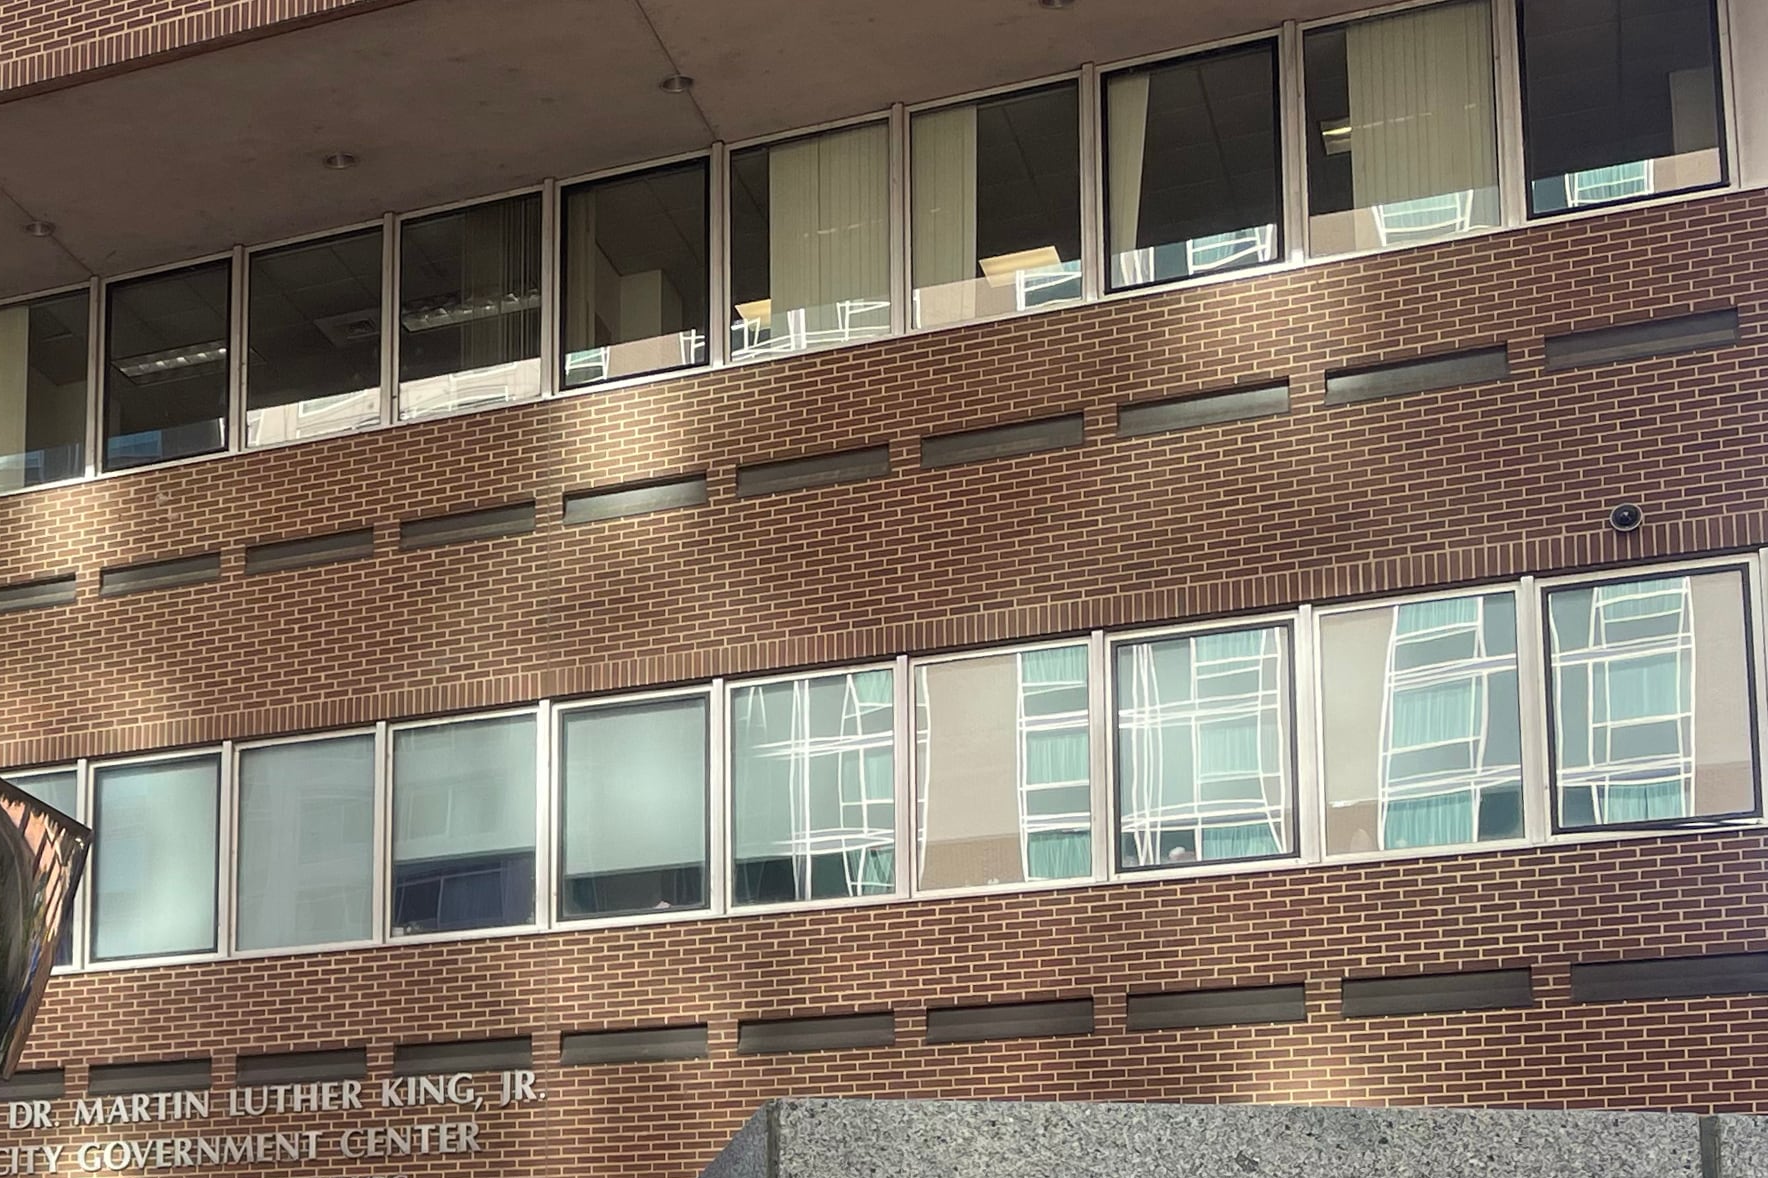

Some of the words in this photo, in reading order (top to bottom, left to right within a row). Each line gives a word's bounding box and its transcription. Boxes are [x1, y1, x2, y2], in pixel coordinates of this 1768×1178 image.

[8, 1100, 61, 1130] DR.
[73, 1089, 210, 1127] MARTIN
[229, 1080, 363, 1116] LUTHER
[382, 1072, 483, 1112] KING,
[499, 1069, 546, 1107] JR.
[76, 1130, 323, 1172] GOVERNMENT
[340, 1122, 482, 1159] CENTER
